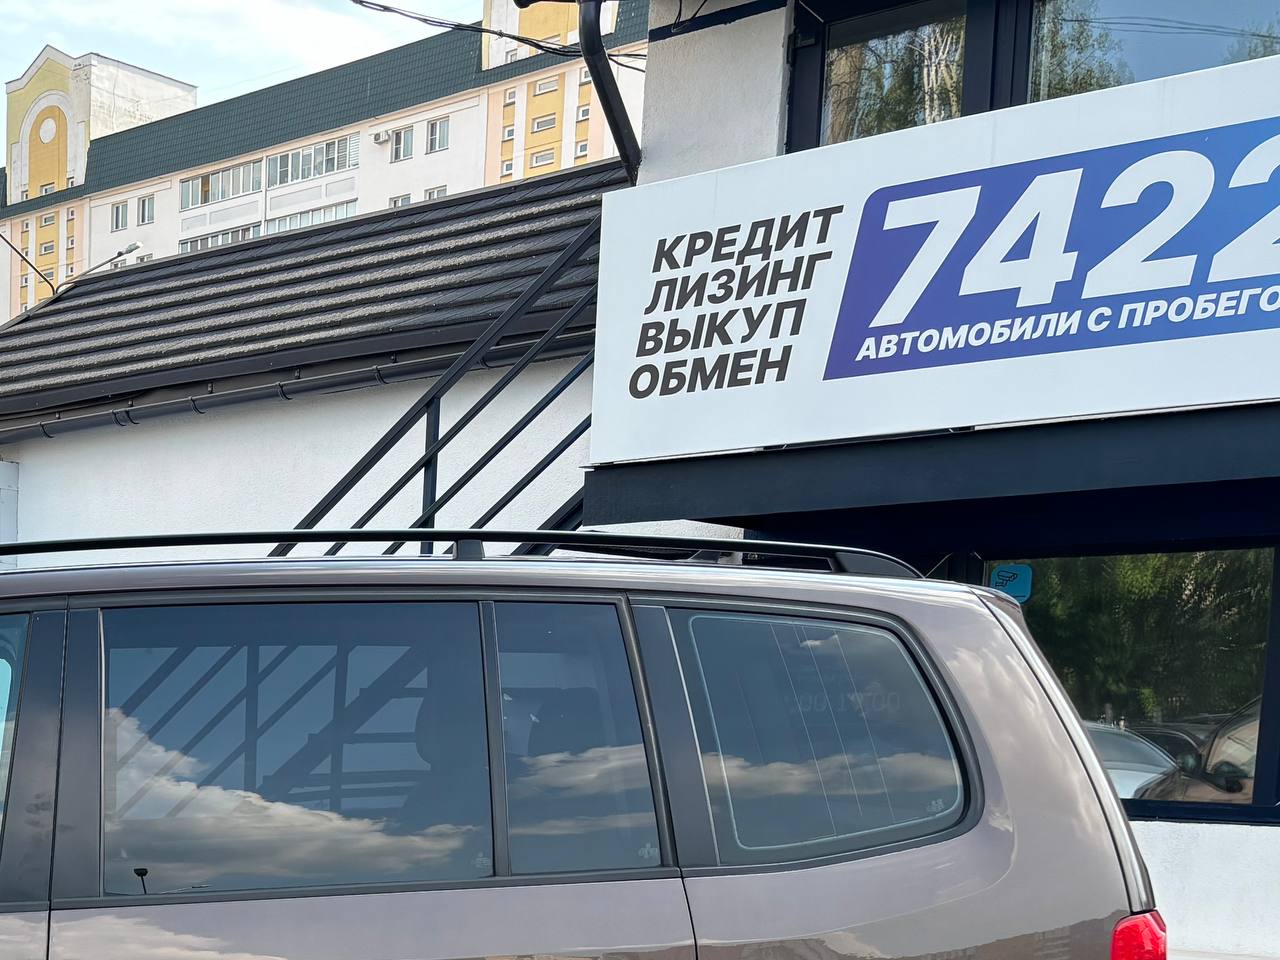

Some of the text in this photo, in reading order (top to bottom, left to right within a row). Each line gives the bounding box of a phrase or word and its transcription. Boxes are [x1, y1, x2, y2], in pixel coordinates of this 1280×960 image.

[652, 205, 844, 273] КРЕДИТ
[644, 251, 832, 315] ЛИЗИНГ
[636, 299, 806, 357] ВЫКУП
[855, 310, 1081, 361] АВТОМОБИЛИ
[1088, 307, 1111, 332] С
[629, 345, 792, 399] ОБМЕН
